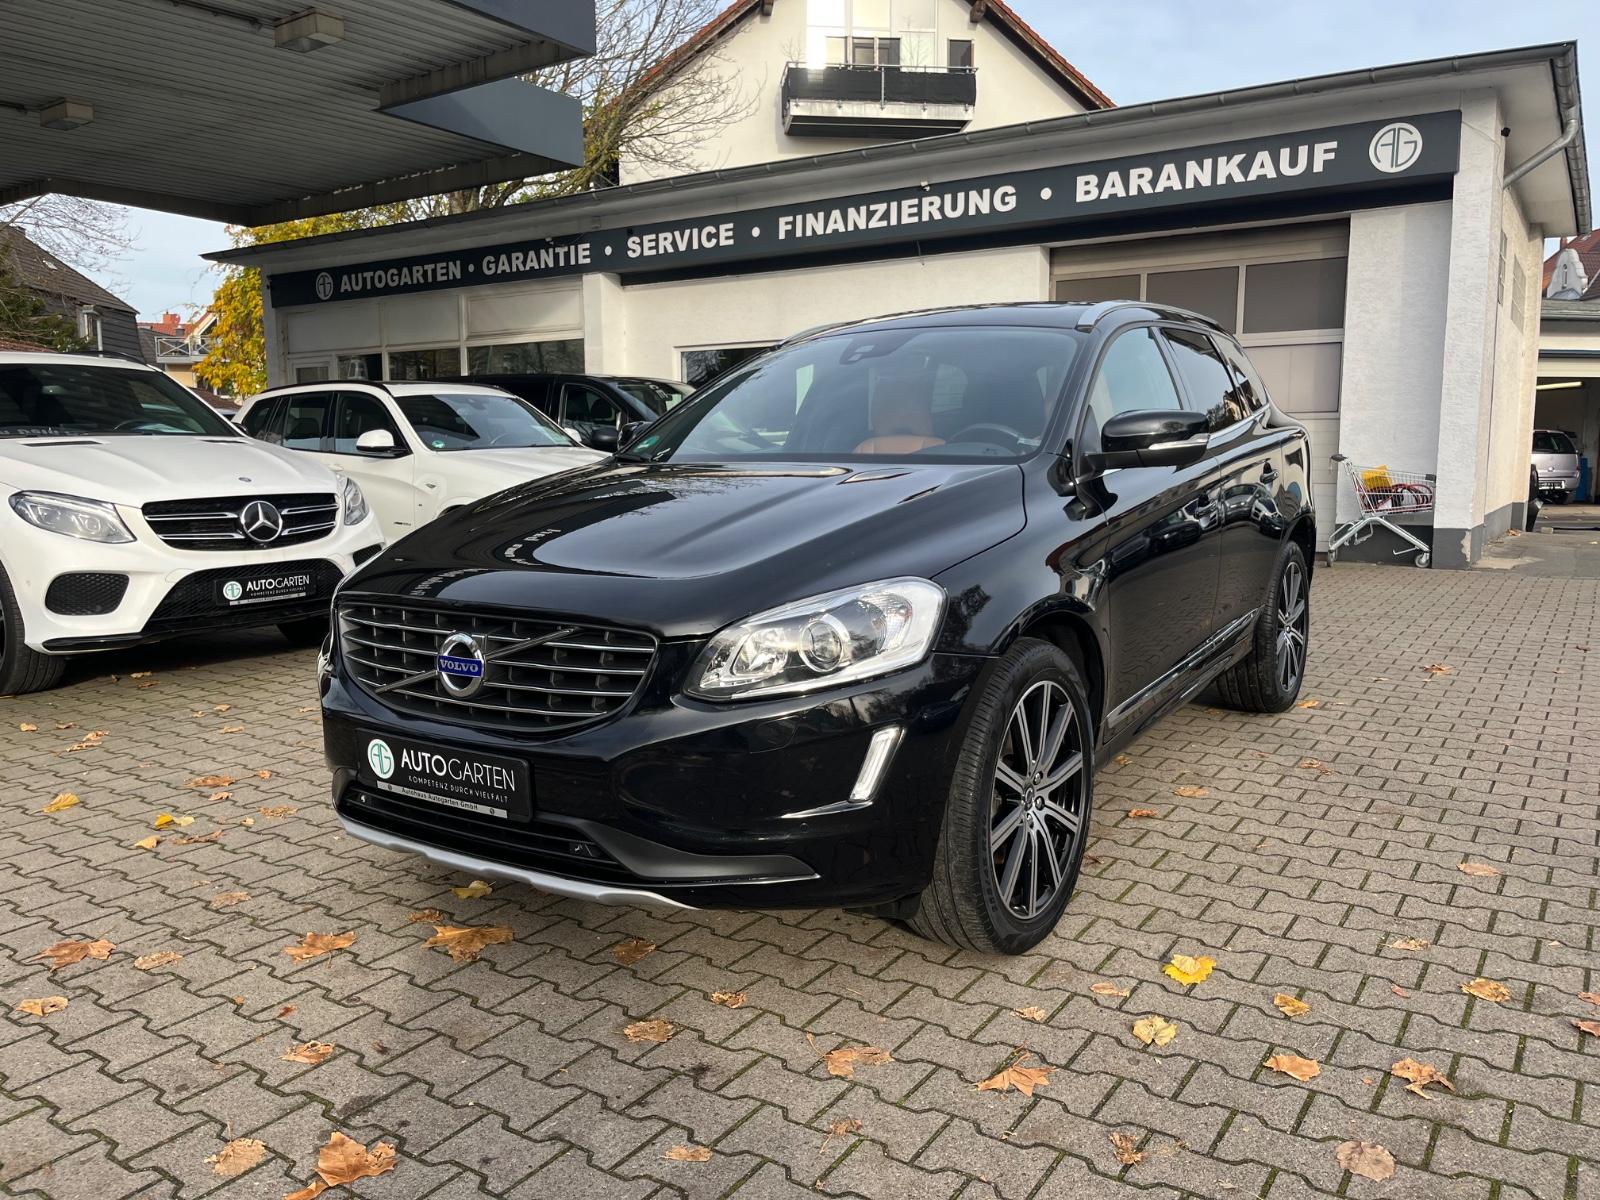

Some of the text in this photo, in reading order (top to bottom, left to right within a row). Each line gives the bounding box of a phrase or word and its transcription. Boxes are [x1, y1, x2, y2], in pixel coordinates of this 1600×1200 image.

[339, 140, 1338, 293] AUTOGARTEN GARANTIE SERVICE FINANZIERUNG BARANKAUF
[246, 575, 310, 591] AUTOGARTEN
[439, 659, 479, 673] VOLVO
[401, 748, 516, 792] AUTOGARTEN
[401, 788, 478, 811] Autohaus Autogarten GmbH
[408, 775, 509, 804] KOMPETENZ DURCH VIELFALT
